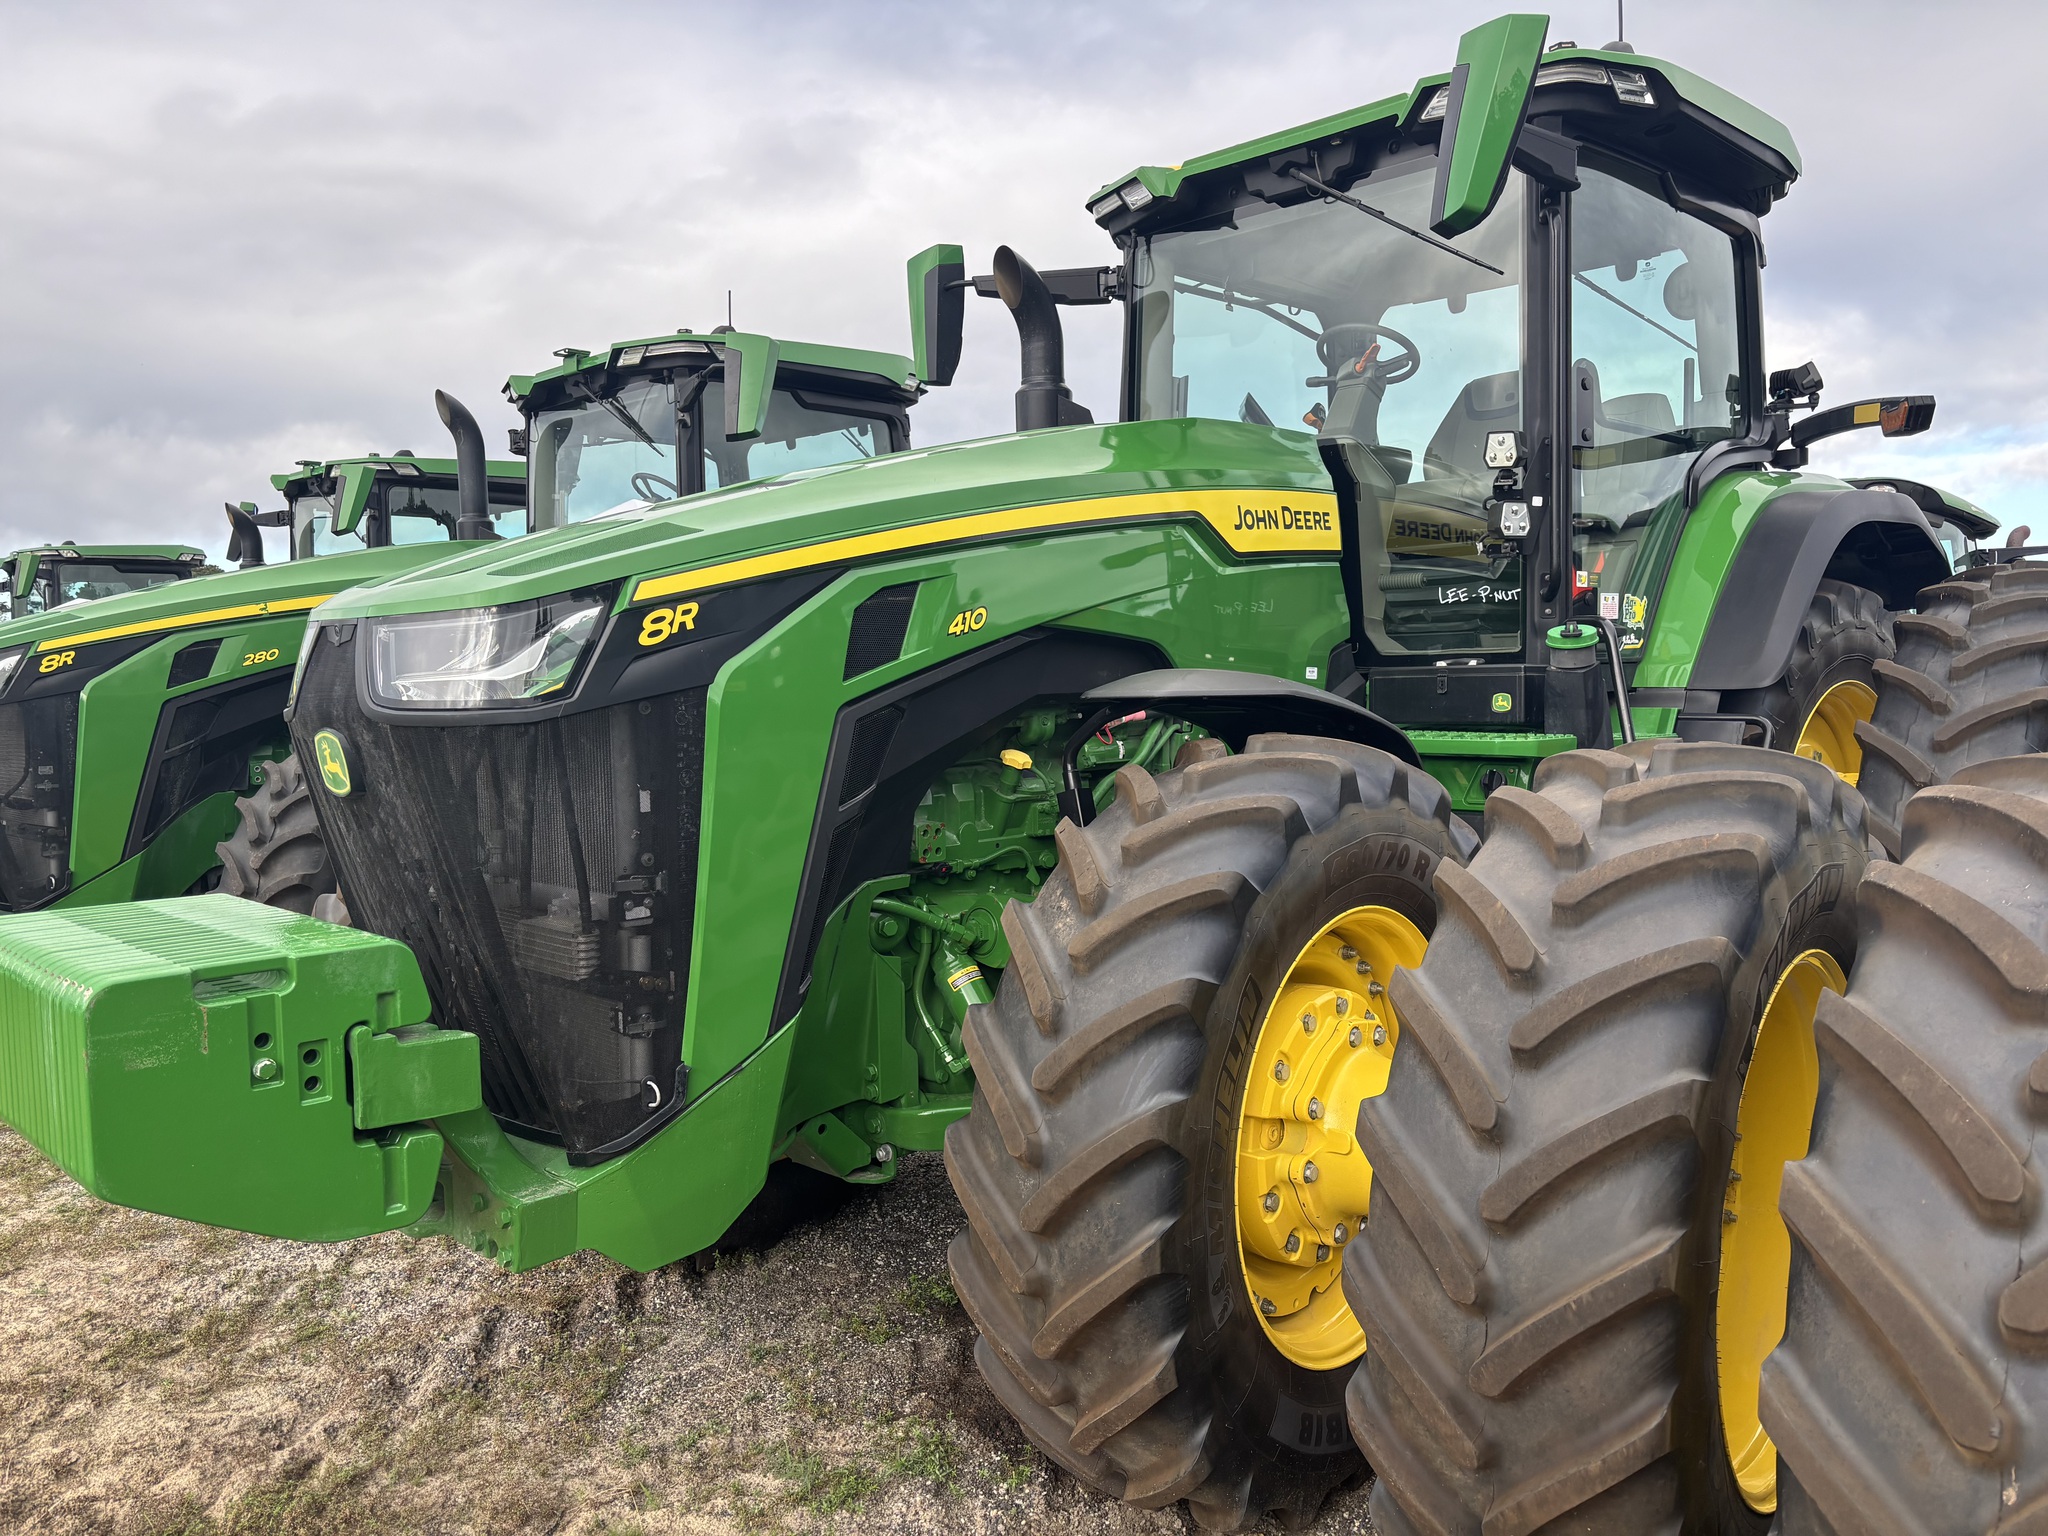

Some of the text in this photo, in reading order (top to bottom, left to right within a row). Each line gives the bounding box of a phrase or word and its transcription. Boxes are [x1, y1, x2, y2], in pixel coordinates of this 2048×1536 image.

[1233, 504, 1332, 531] JOHN DEERE
[638, 602, 699, 646] 8R
[948, 606, 988, 637] 410
[39, 650, 76, 673] 8R
[242, 648, 280, 667] 280
[1206, 980, 1260, 1256] MICHELIN
